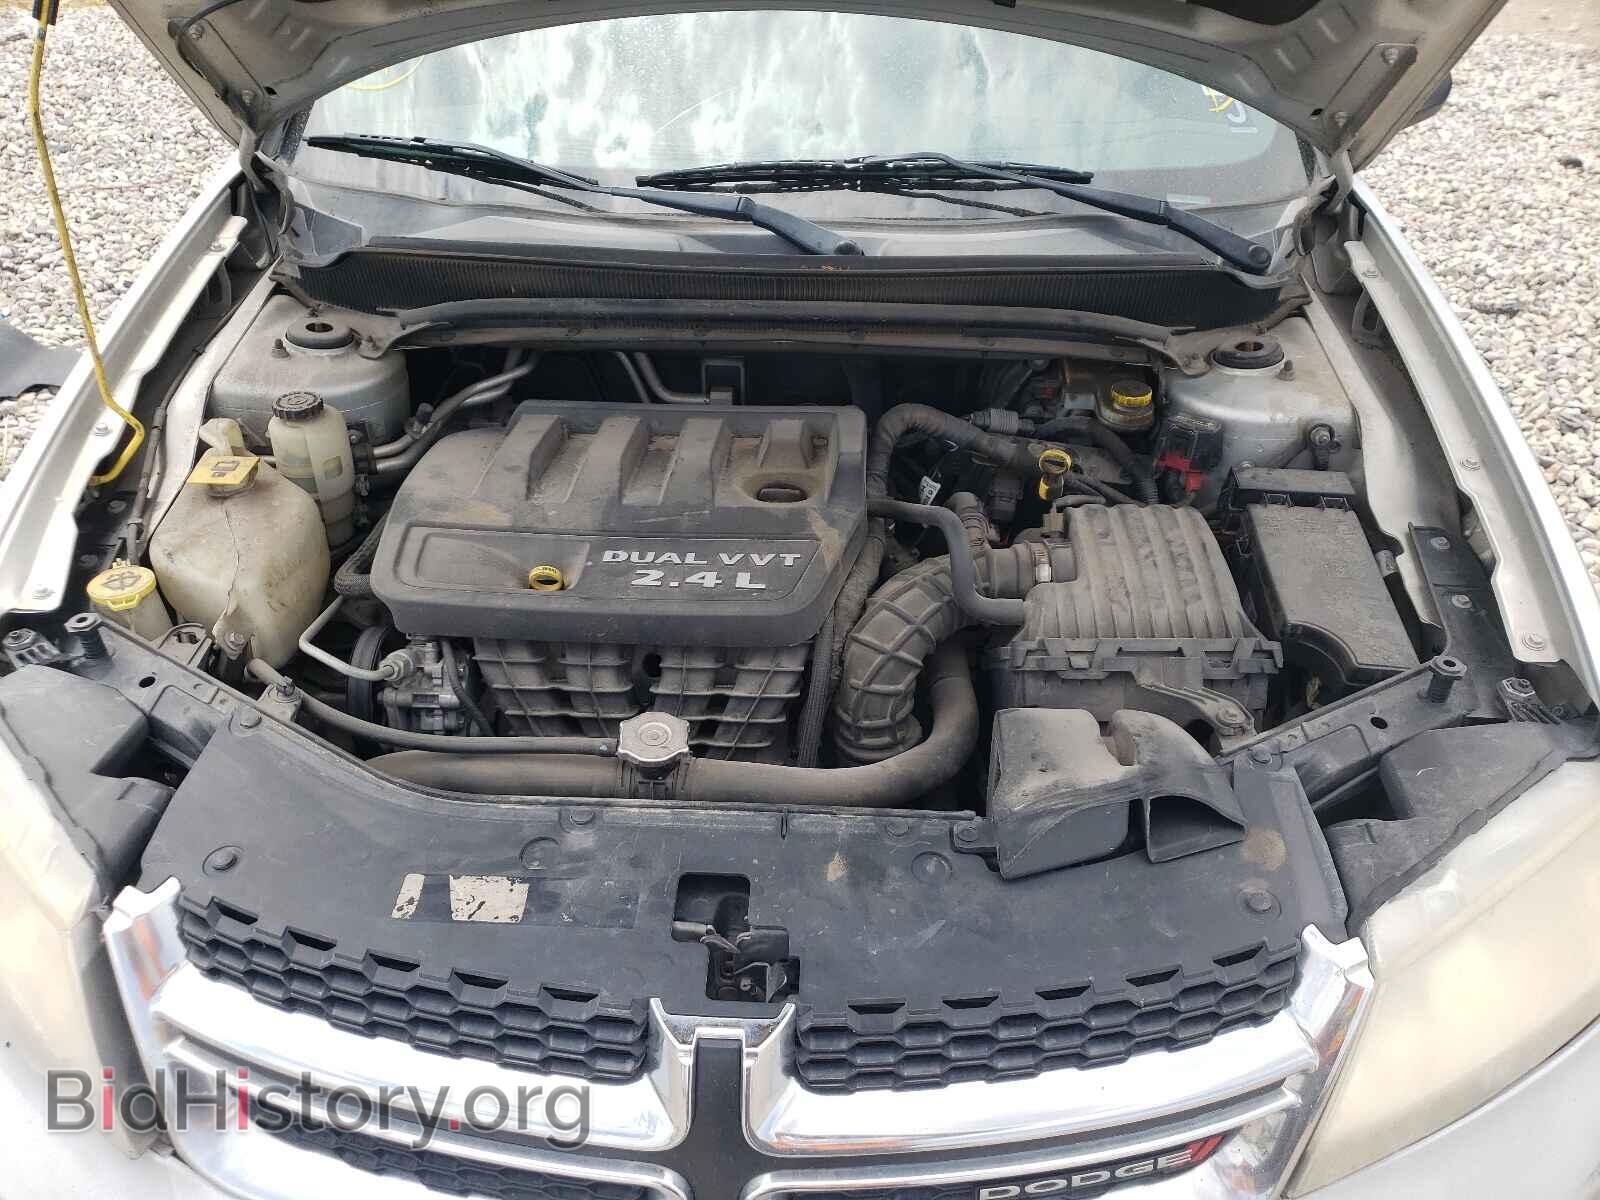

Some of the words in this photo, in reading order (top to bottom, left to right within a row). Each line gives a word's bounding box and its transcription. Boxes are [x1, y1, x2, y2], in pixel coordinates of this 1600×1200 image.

[602, 551, 708, 565] DUAL
[719, 552, 801, 566] VVT
[979, 1151, 1193, 1200] DODGE
